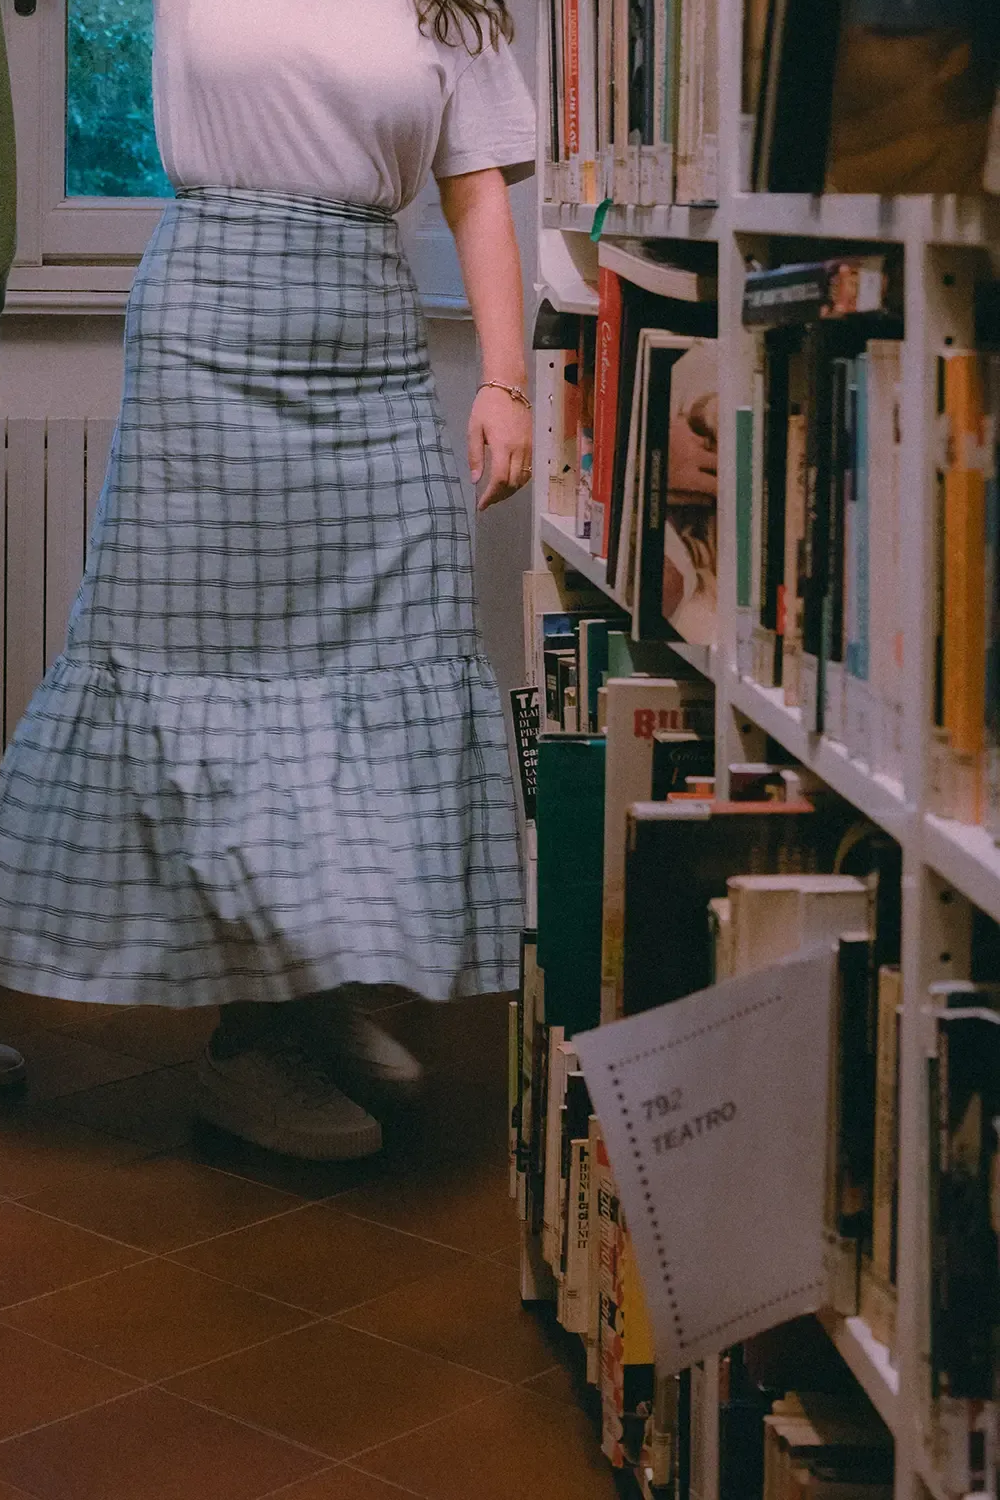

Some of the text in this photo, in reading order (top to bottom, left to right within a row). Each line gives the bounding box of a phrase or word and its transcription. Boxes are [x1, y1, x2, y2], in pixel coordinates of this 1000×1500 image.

[519, 719, 530, 728] DI
[641, 1087, 683, 1121] 792
[652, 1100, 738, 1156] TEATRO
